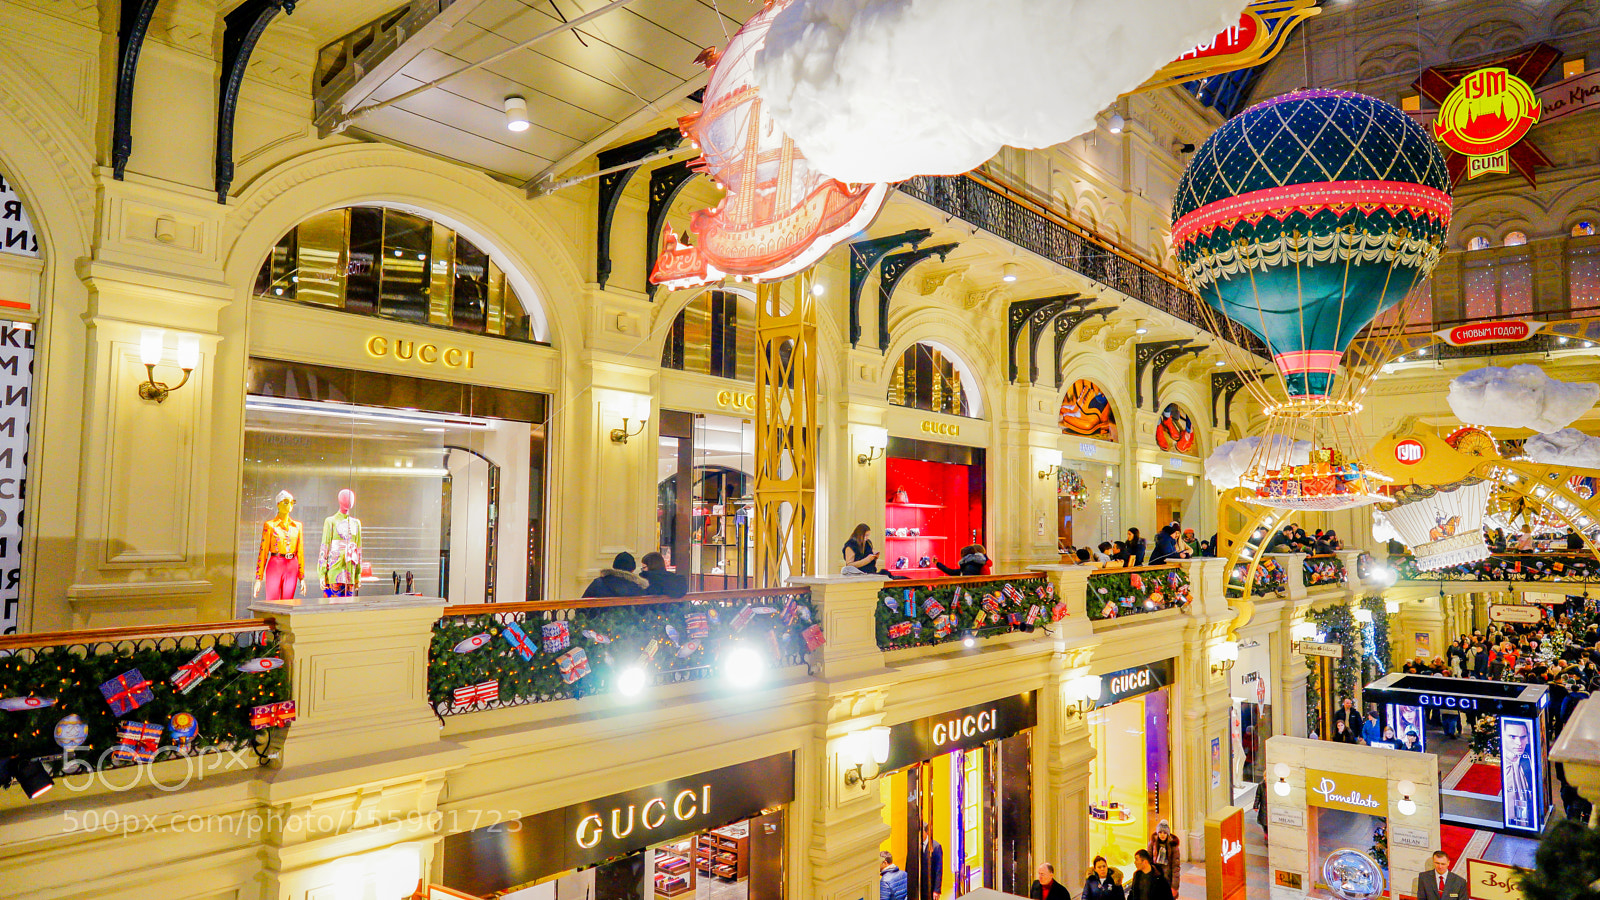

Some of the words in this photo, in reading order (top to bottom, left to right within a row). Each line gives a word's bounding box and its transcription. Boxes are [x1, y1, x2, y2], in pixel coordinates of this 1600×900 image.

[1464, 70, 1506, 99] ГУМ
[1472, 155, 1504, 171] GUM
[1456, 331, 1461, 339] С
[1462, 327, 1492, 339] НОВЫМ
[1493, 326, 1525, 337] ГОДОМ!
[366, 335, 475, 369] GUCCI
[921, 419, 960, 437] GUCCI
[1397, 444, 1421, 461] ГУМ
[1111, 669, 1150, 695] GUCCI
[1419, 694, 1478, 710] GUCCI
[932, 708, 997, 746] GUCCI
[1312, 776, 1380, 808] Pomellato
[575, 784, 712, 849] GUCCI
[1401, 837, 1421, 846] MILAN
